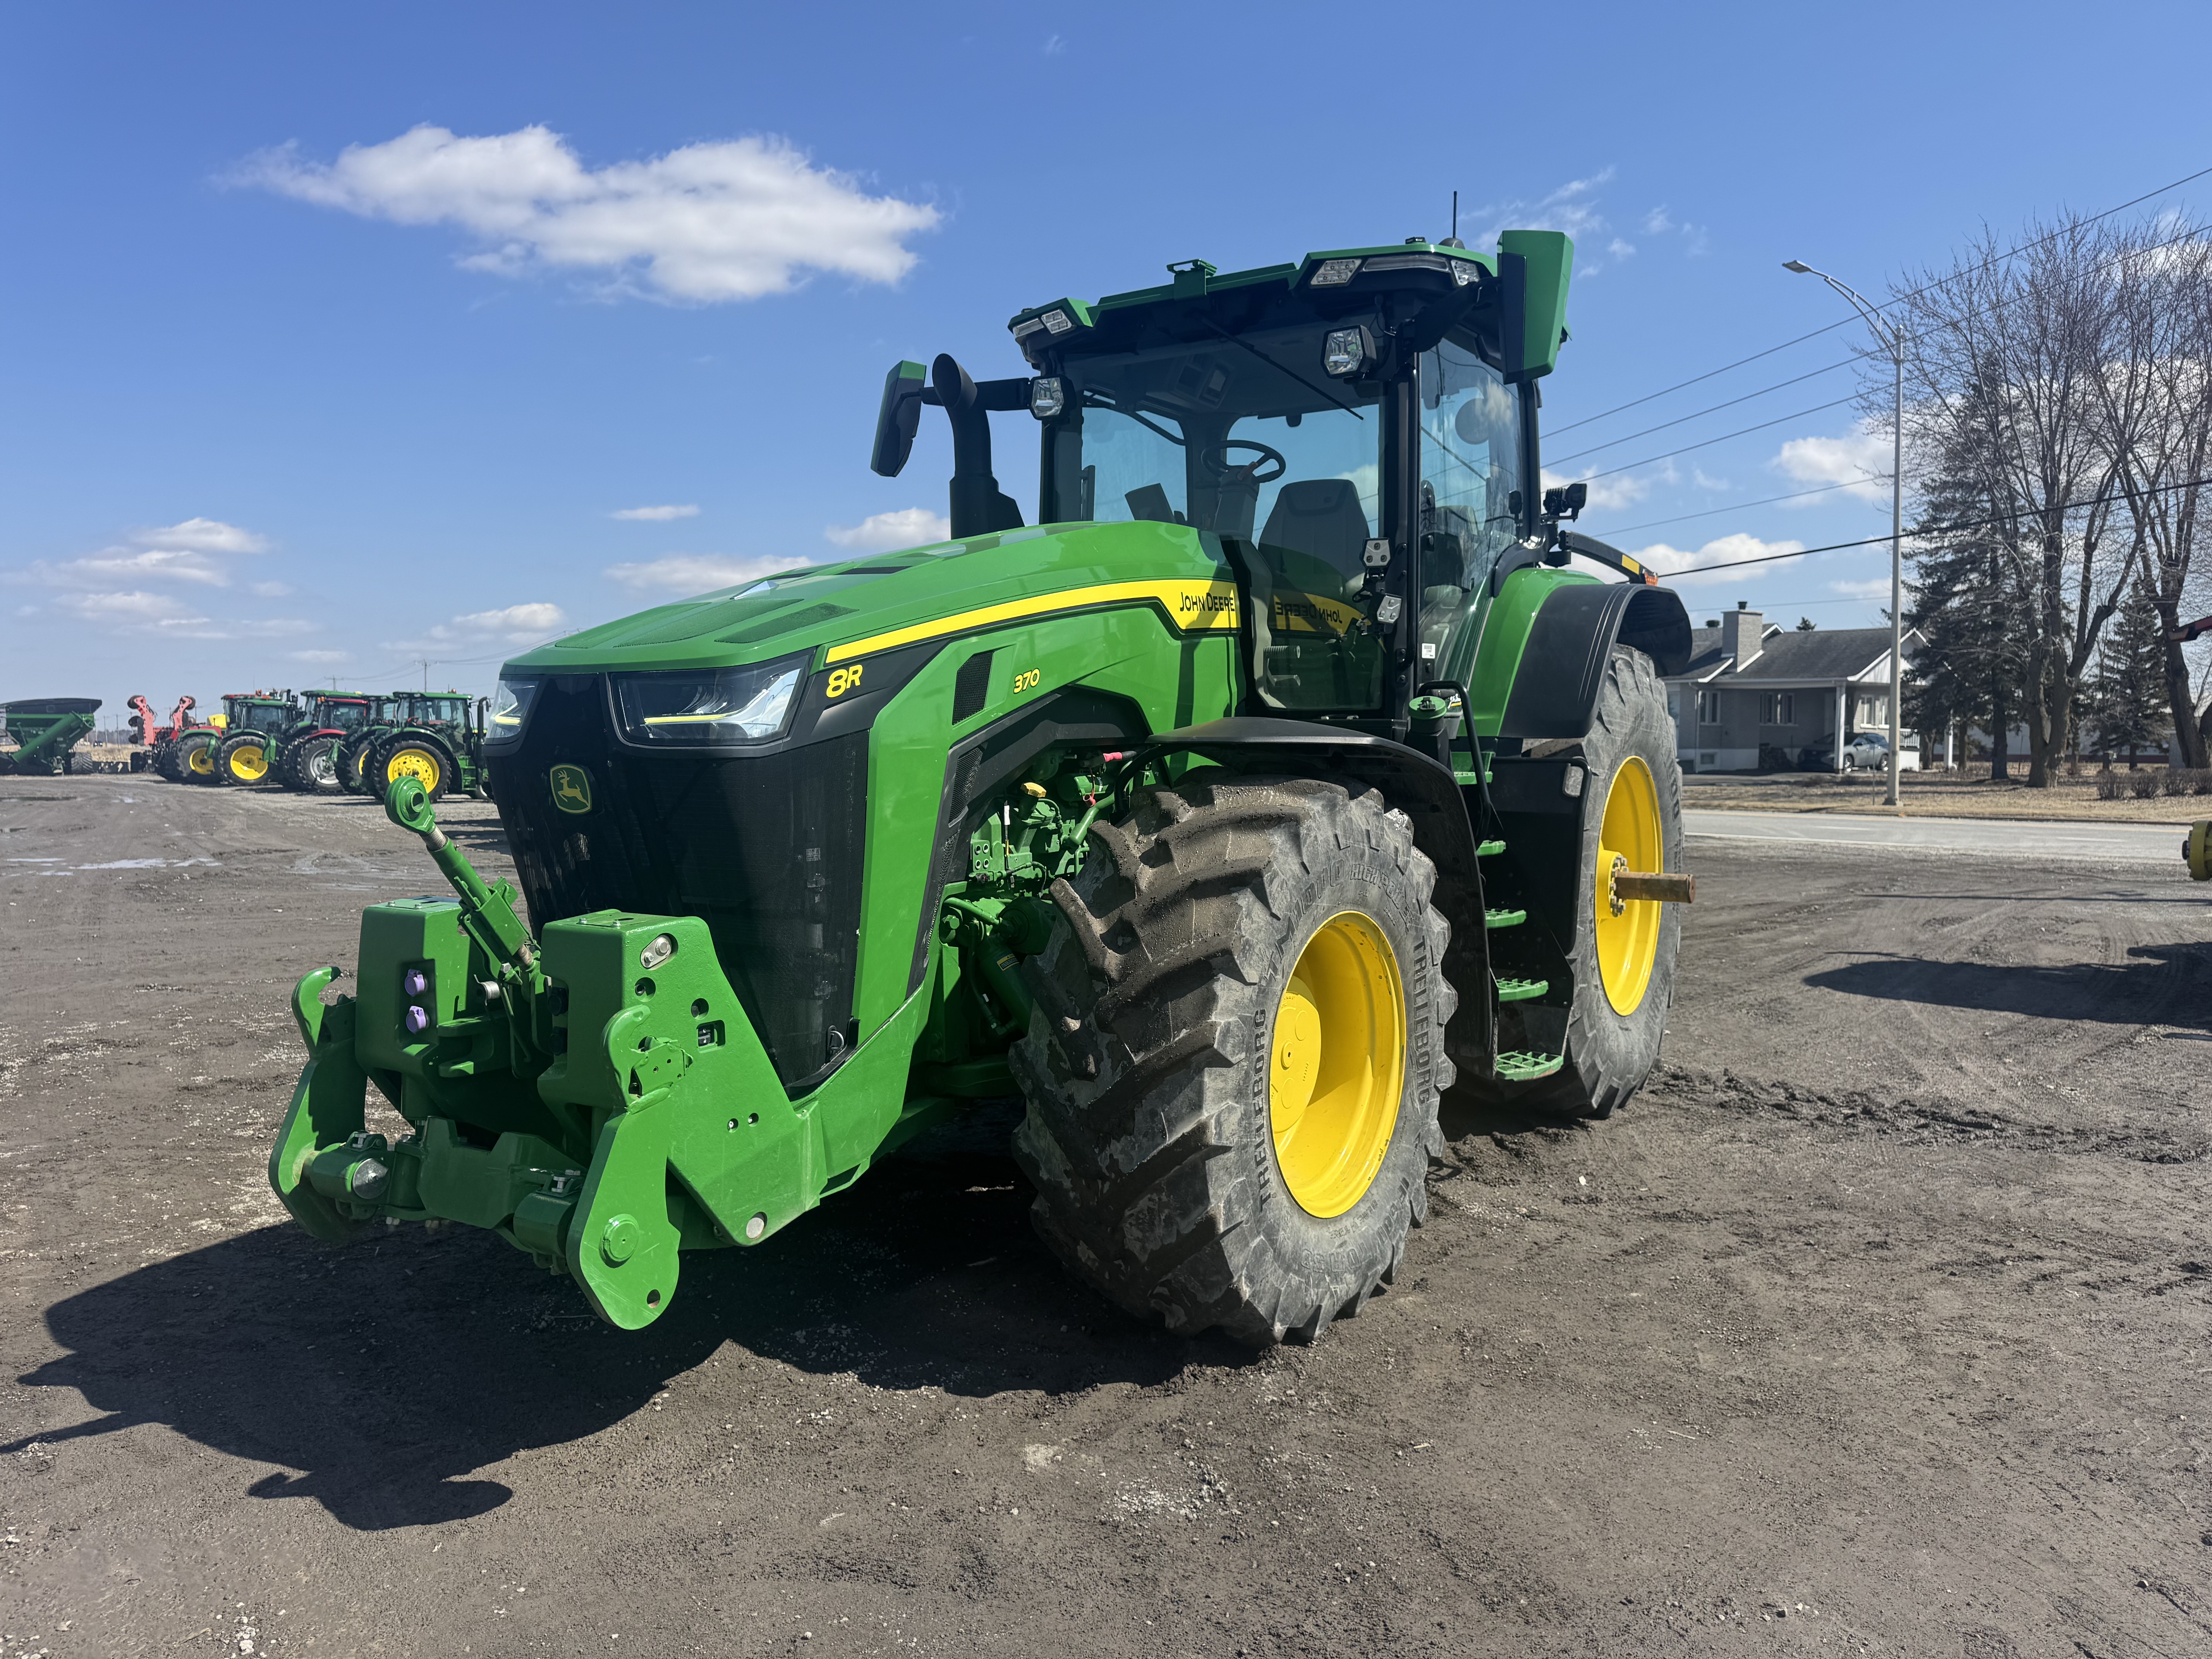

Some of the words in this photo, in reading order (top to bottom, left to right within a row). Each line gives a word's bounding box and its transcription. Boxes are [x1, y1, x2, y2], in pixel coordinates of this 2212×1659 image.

[1180, 591, 1205, 611] JOHN
[1206, 592, 1235, 611] DEERE
[826, 665, 863, 698] 8R
[1013, 668, 1041, 694] 370
[1413, 934, 1431, 1106] TRELLEBORG
[1252, 1009, 1271, 1213] TRELLEBORG
